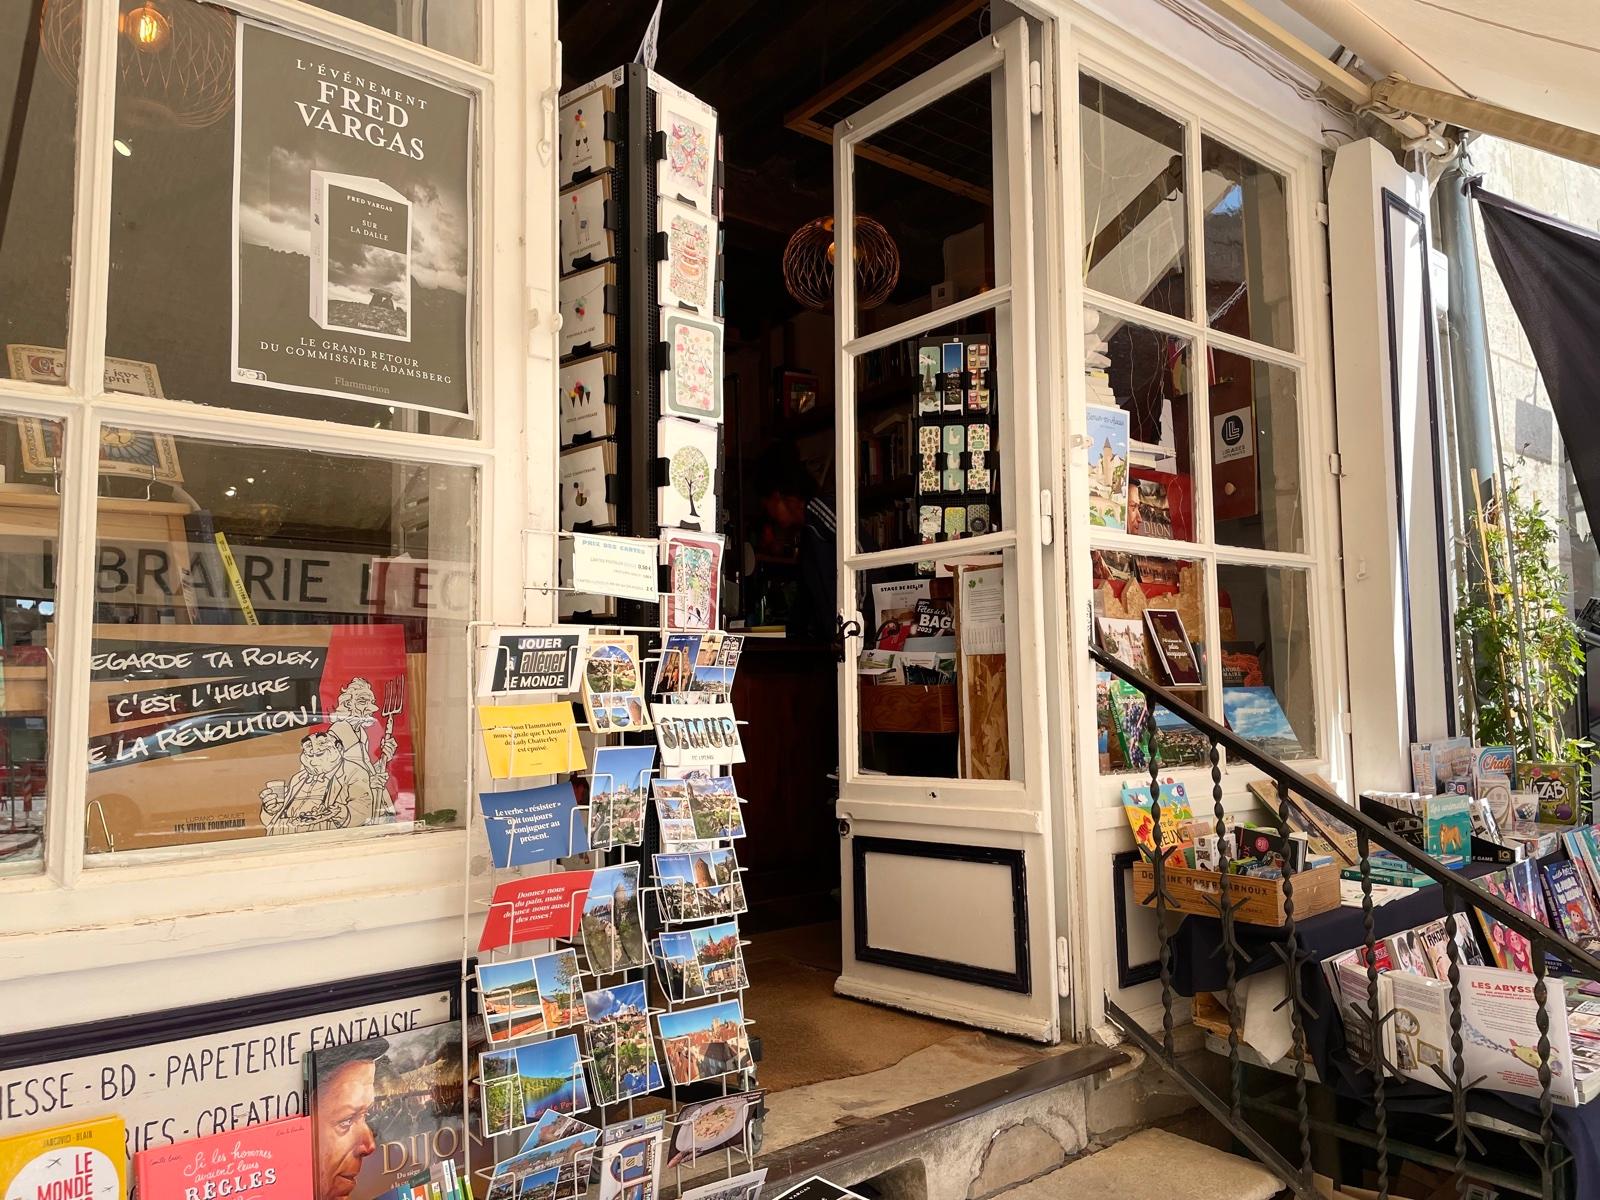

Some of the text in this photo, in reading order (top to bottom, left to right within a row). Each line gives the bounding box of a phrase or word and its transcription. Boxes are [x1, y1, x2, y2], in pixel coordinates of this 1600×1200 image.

[296, 59, 427, 110] L'ÉVÉNEMENT
[317, 80, 409, 128] FRED
[294, 101, 425, 161] VARGAS
[346, 194, 393, 212] FRED VARGAS
[350, 226, 389, 241] LA DALLE
[362, 219, 378, 230] SUR
[300, 337, 419, 368] LE GRAND RETOUR
[260, 341, 452, 384] DU COMMISSAIRE ADAMSBERG
[334, 376, 390, 394] Flammarion
[1143, 521, 1171, 537] DIJON
[917, 626, 933, 634] 2023
[919, 613, 955, 630] BAG
[517, 637, 562, 650] JOUER
[91, 647, 319, 671] EGARDE TA ROLEX,
[521, 651, 566, 673] alléger
[519, 675, 565, 688] MONDE
[116, 675, 291, 718] C'EST L'HEURE
[524, 721, 562, 730] Flammarion
[660, 716, 739, 750] SEMUR
[527, 736, 558, 744] Chatterley
[529, 731, 541, 739] que
[89, 743, 108, 765] E
[116, 736, 149, 761] LA
[1481, 754, 1514, 772] Chats
[494, 802, 557, 817] Le verbe résister
[522, 812, 553, 824] toujours
[174, 818, 246, 833] LES VIEUX FOURNEAUX
[513, 822, 550, 835] conjuguer
[550, 819, 561, 827] au
[519, 831, 550, 845] présent.
[1141, 870, 1185, 884] DOINE
[1186, 876, 1218, 889] ROBER
[514, 894, 563, 908] du pain, mais
[517, 886, 566, 900] Donnez nous
[531, 904, 550, 913] nous
[550, 901, 571, 910] aussi
[515, 915, 528, 924] des
[1471, 981, 1492, 990] LES
[101, 1063, 136, 1101] BD
[166, 1031, 301, 1088] PAPETERIE
[197, 1091, 300, 1139] CREATIO
[380, 1117, 483, 1175] DIJON
[75, 1151, 93, 1176] LE
[183, 1152, 206, 1177] Si
[211, 1149, 227, 1164] les
[231, 1141, 273, 1160] hommes
[194, 1162, 234, 1183] avaient
[37, 1174, 93, 1200] MONDE
